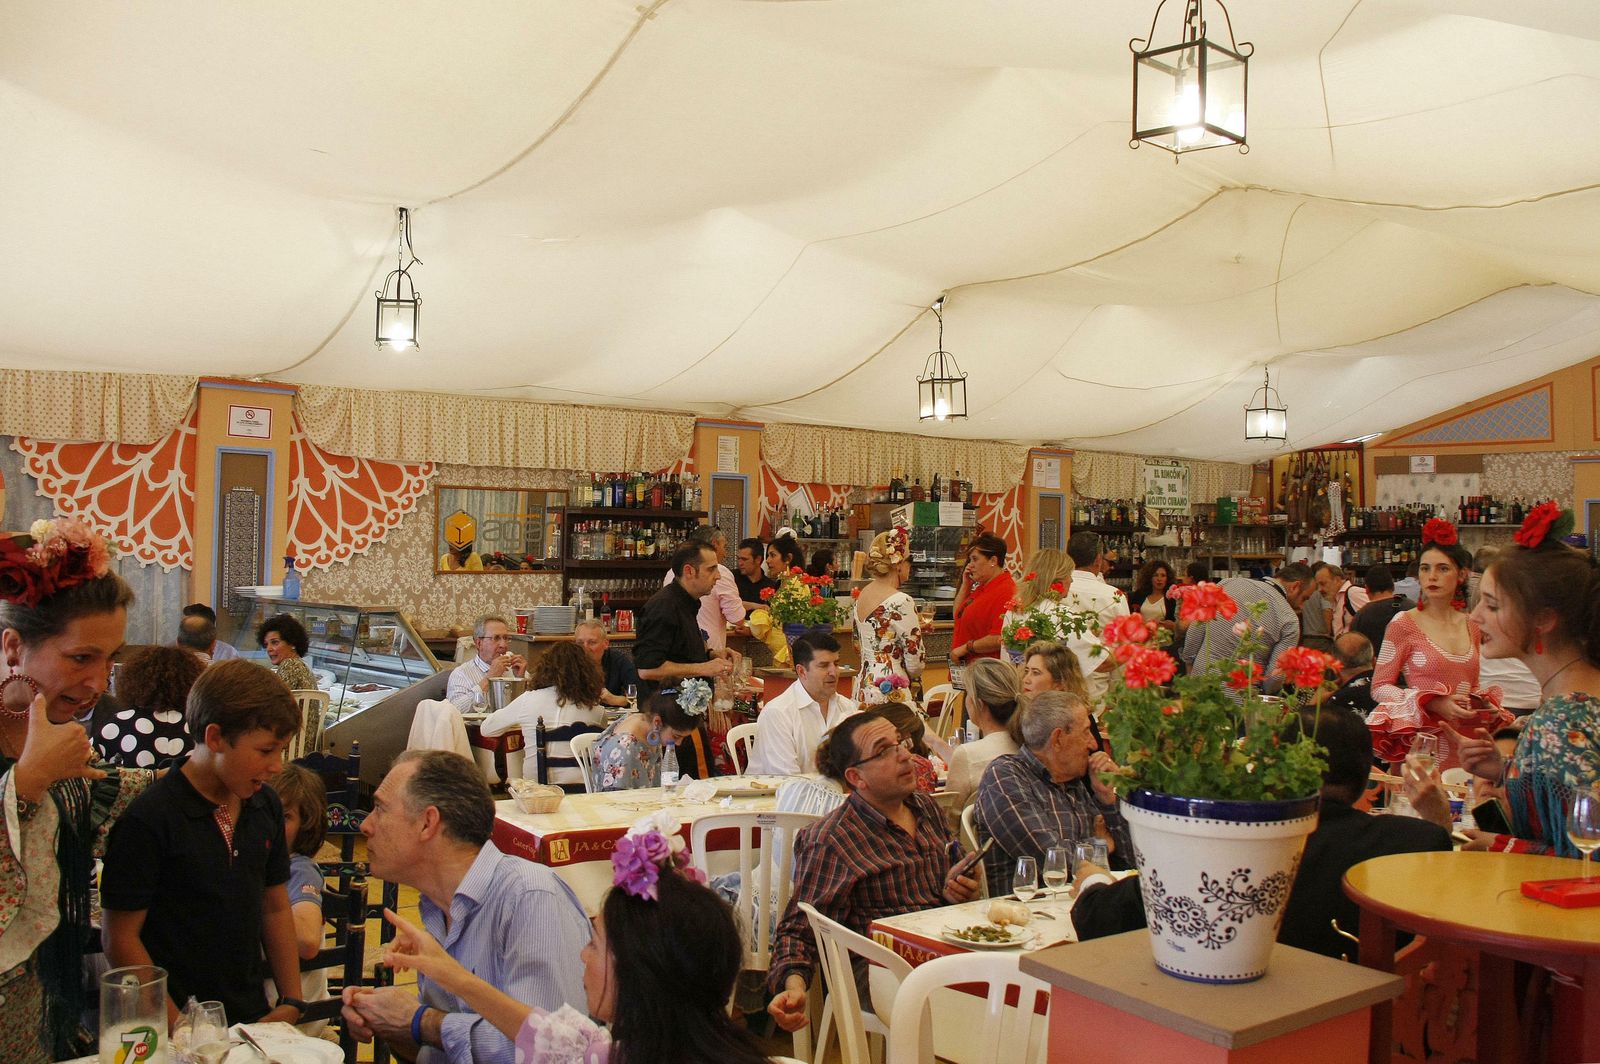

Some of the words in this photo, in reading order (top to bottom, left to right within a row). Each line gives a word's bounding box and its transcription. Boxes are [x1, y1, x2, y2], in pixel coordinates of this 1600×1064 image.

[1154, 469, 1160, 478] EL
[1161, 468, 1180, 479] RINCÓN
[1168, 484, 1177, 492] DEL
[1148, 496, 1166, 506] MOJITO
[1168, 496, 1187, 506] CUBANO
